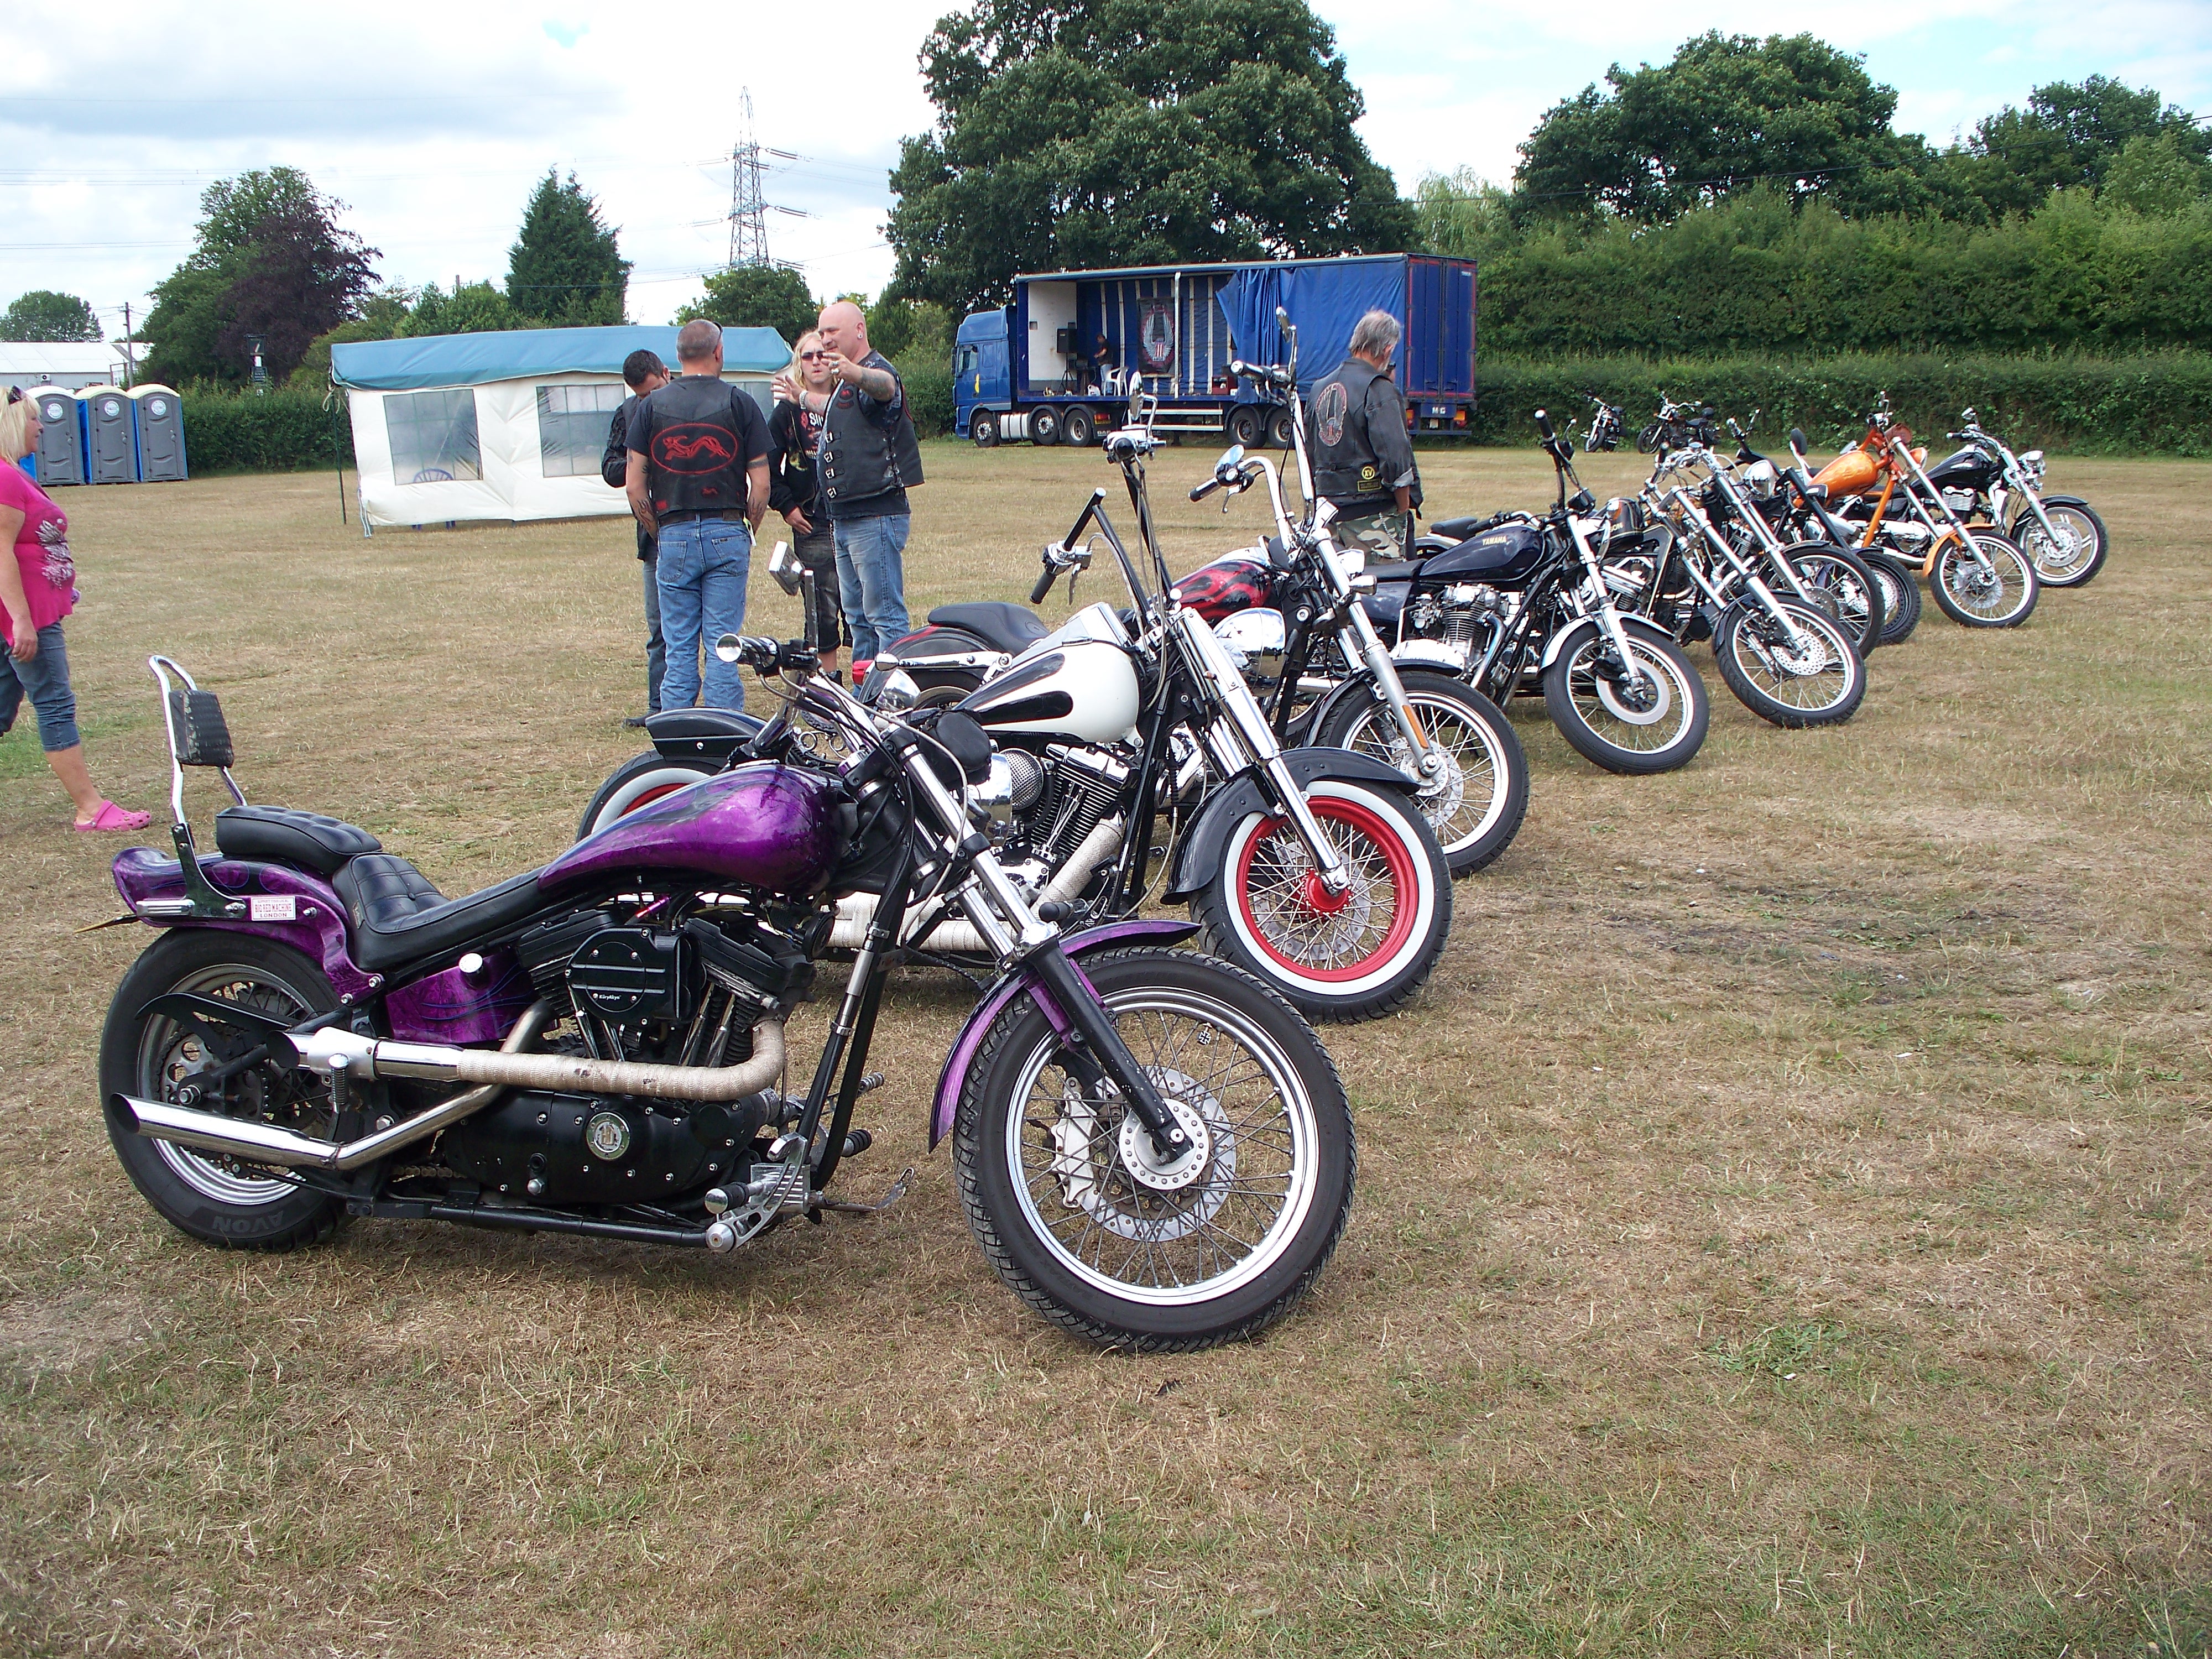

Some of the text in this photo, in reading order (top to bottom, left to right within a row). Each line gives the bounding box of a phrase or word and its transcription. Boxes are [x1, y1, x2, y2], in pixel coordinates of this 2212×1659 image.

[1482, 536, 1507, 546] YAMAHA
[263, 904, 271, 912] RED
[272, 903, 292, 912] MACHINE
[212, 1210, 284, 1233] AVON
